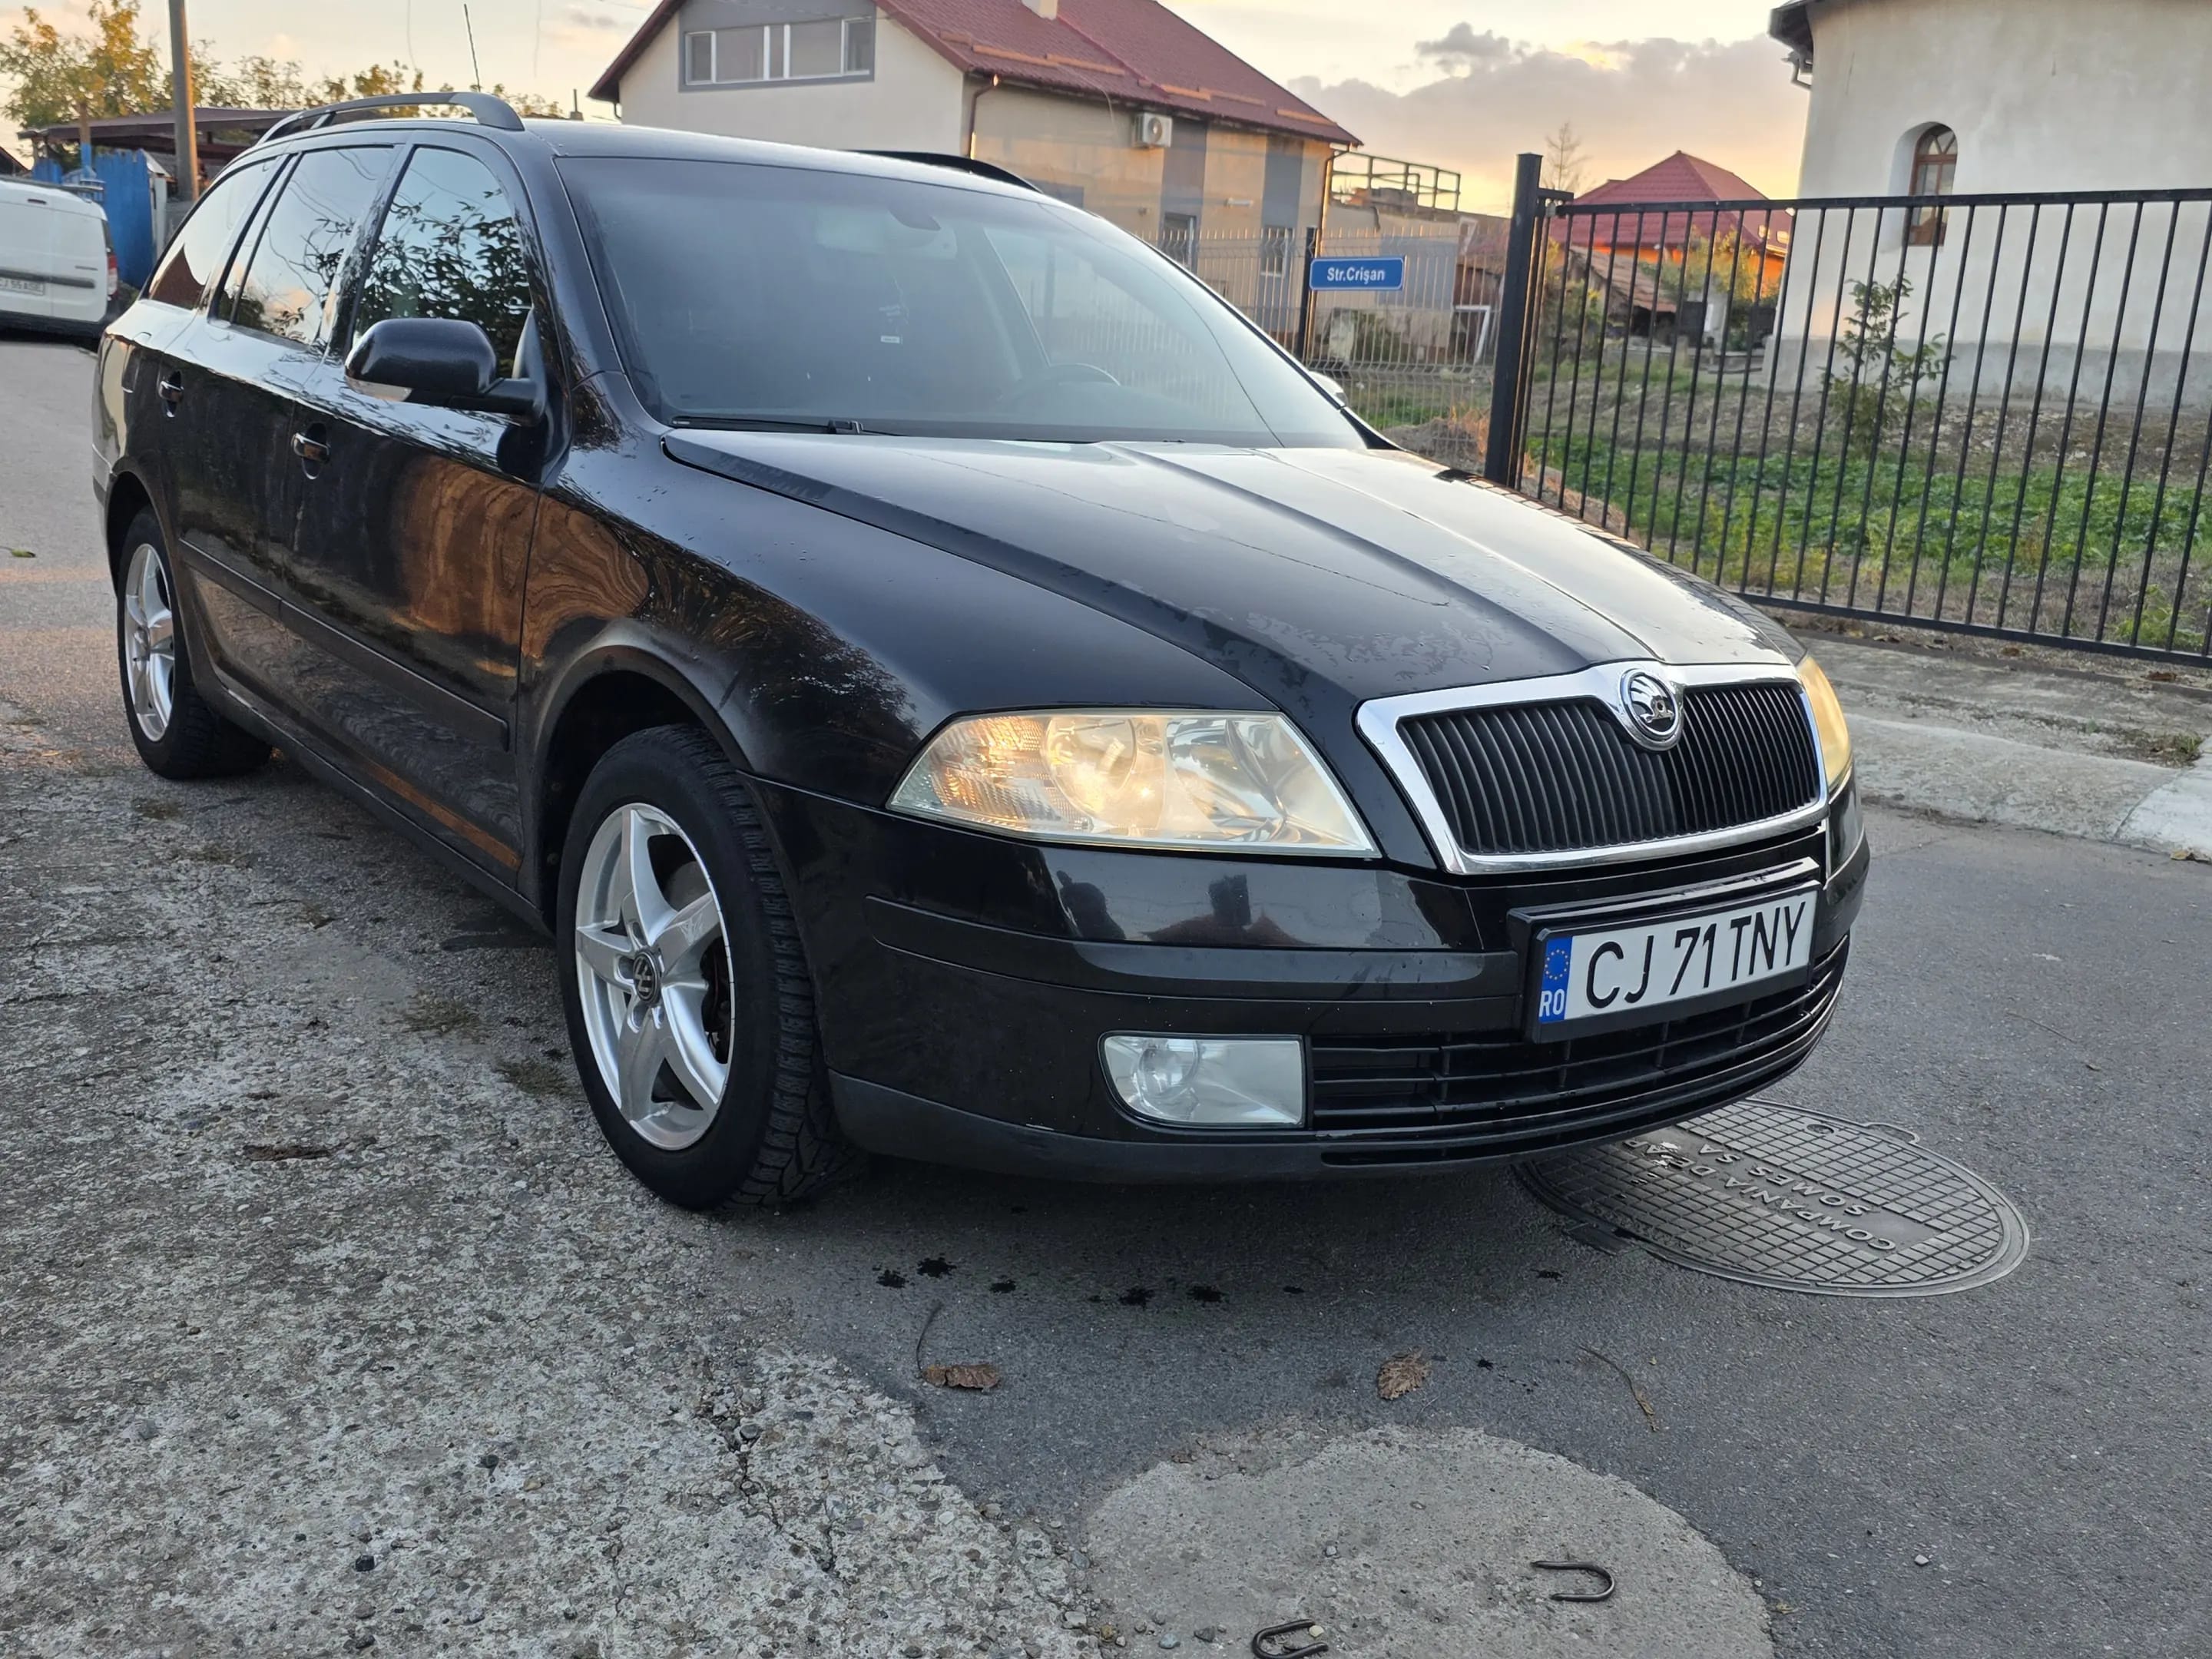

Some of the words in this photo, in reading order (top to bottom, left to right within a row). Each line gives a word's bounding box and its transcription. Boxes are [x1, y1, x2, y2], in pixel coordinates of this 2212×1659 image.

[1586, 935, 1654, 1008] CJ
[1669, 923, 1717, 996] 71
[1730, 901, 1806, 982] TNY
[1539, 988, 1565, 1018] RO
[1699, 1144, 1741, 1164] SA
[1725, 1177, 1896, 1250] COMPANIA
